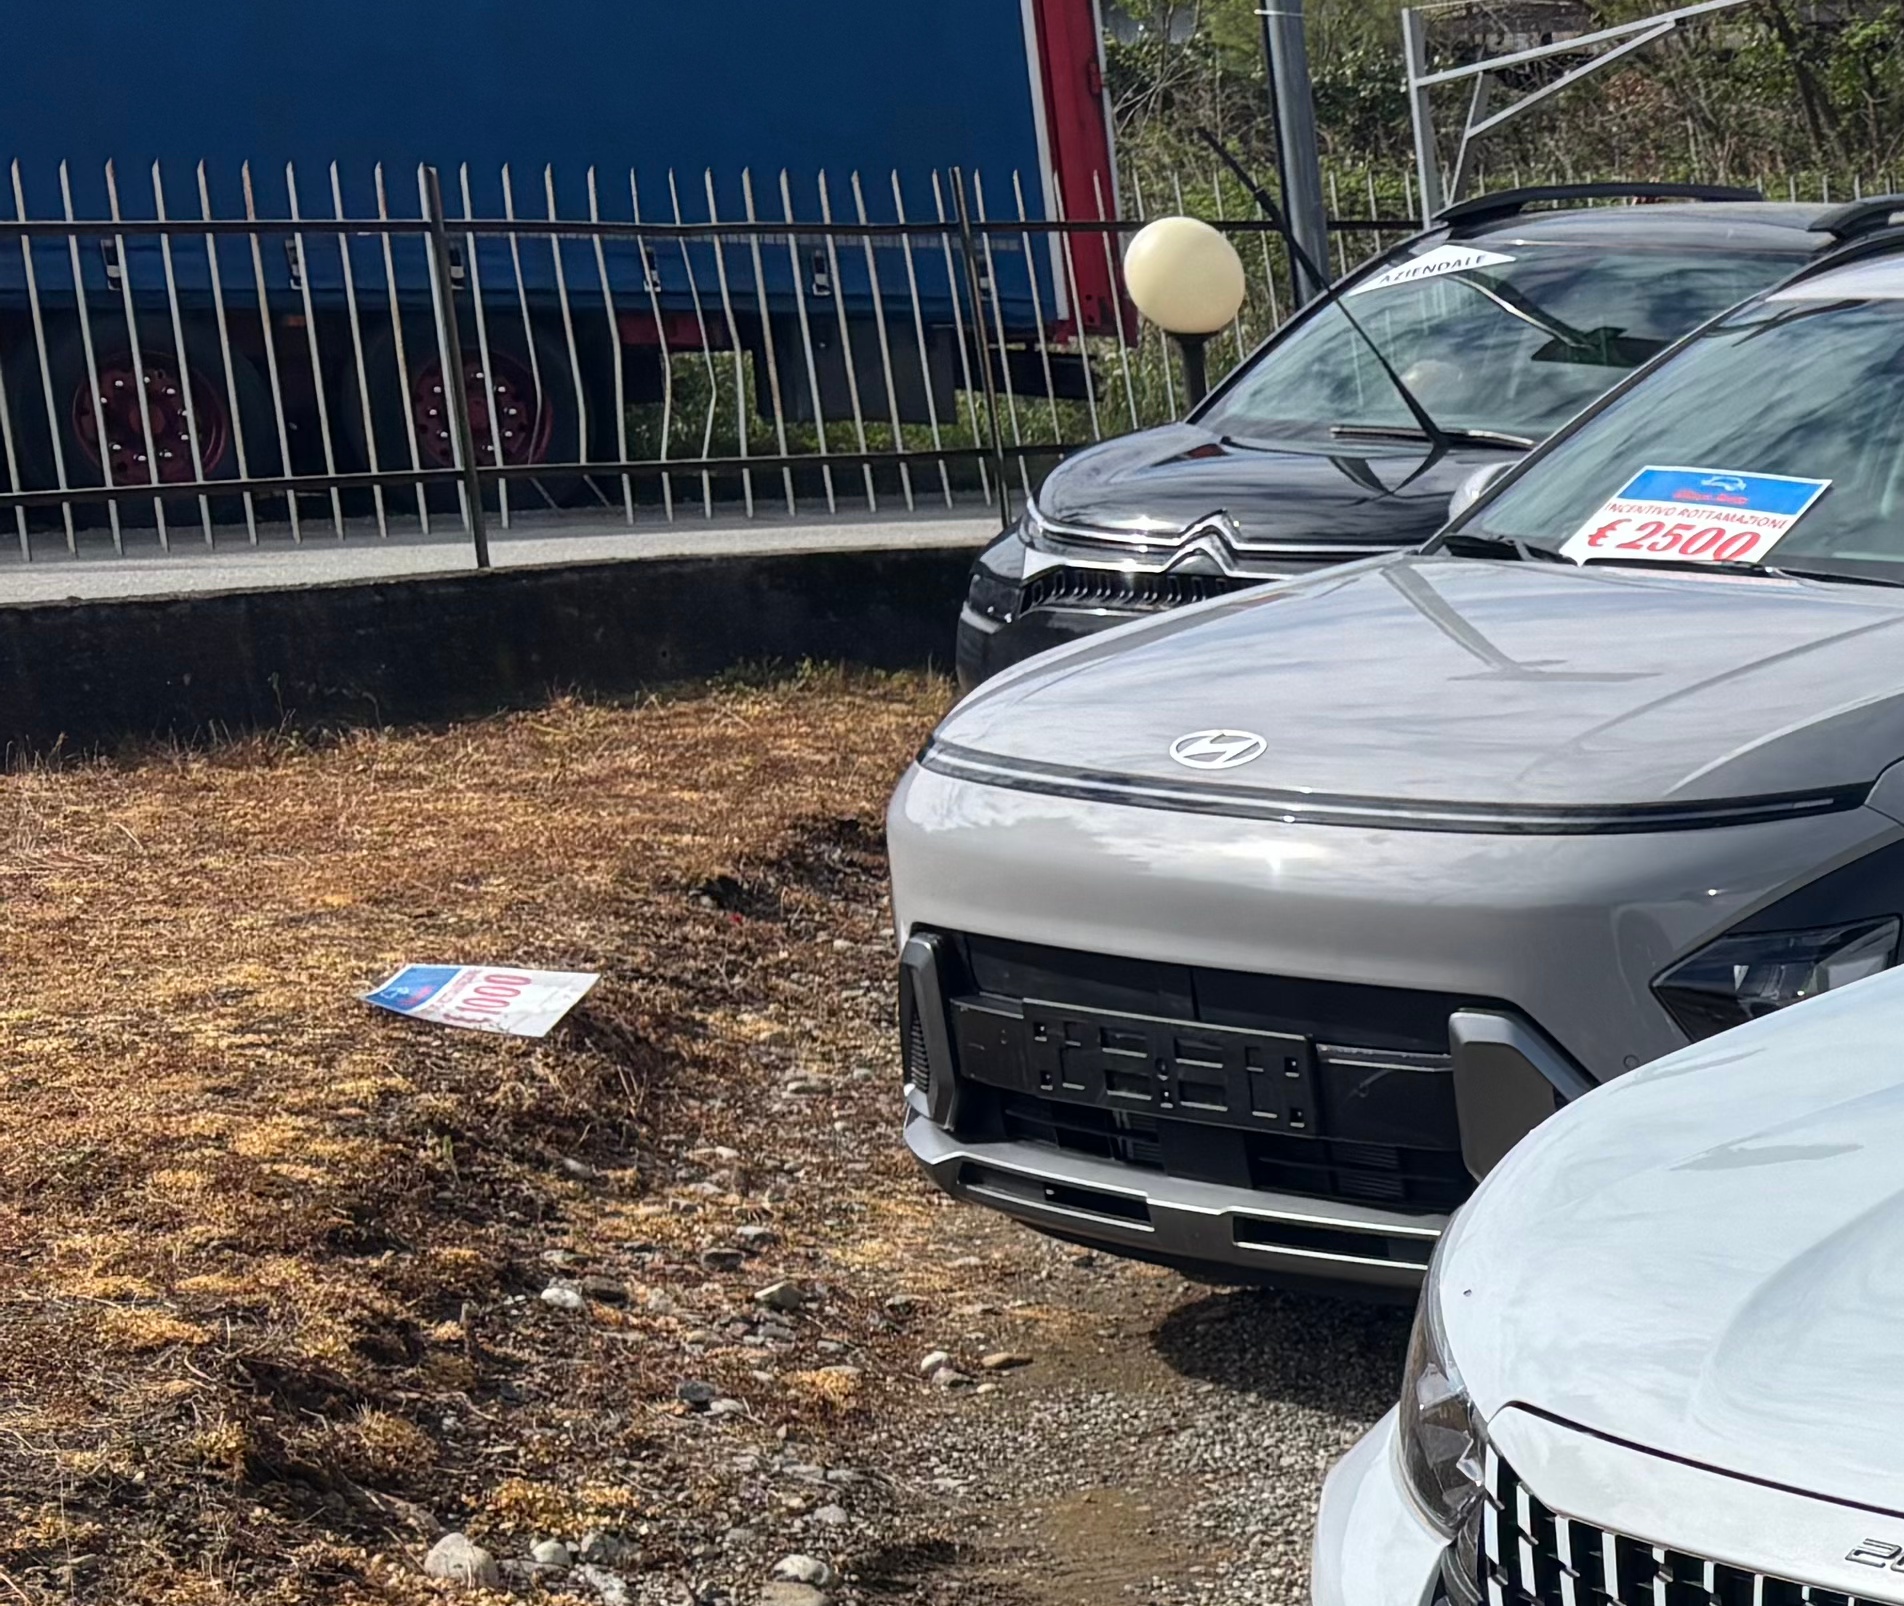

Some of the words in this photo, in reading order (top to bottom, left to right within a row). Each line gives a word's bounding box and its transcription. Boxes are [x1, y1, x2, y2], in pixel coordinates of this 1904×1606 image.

[1587, 518, 1631, 548] €
[1616, 520, 1761, 562] 2500
[454, 973, 532, 1016] 1000
